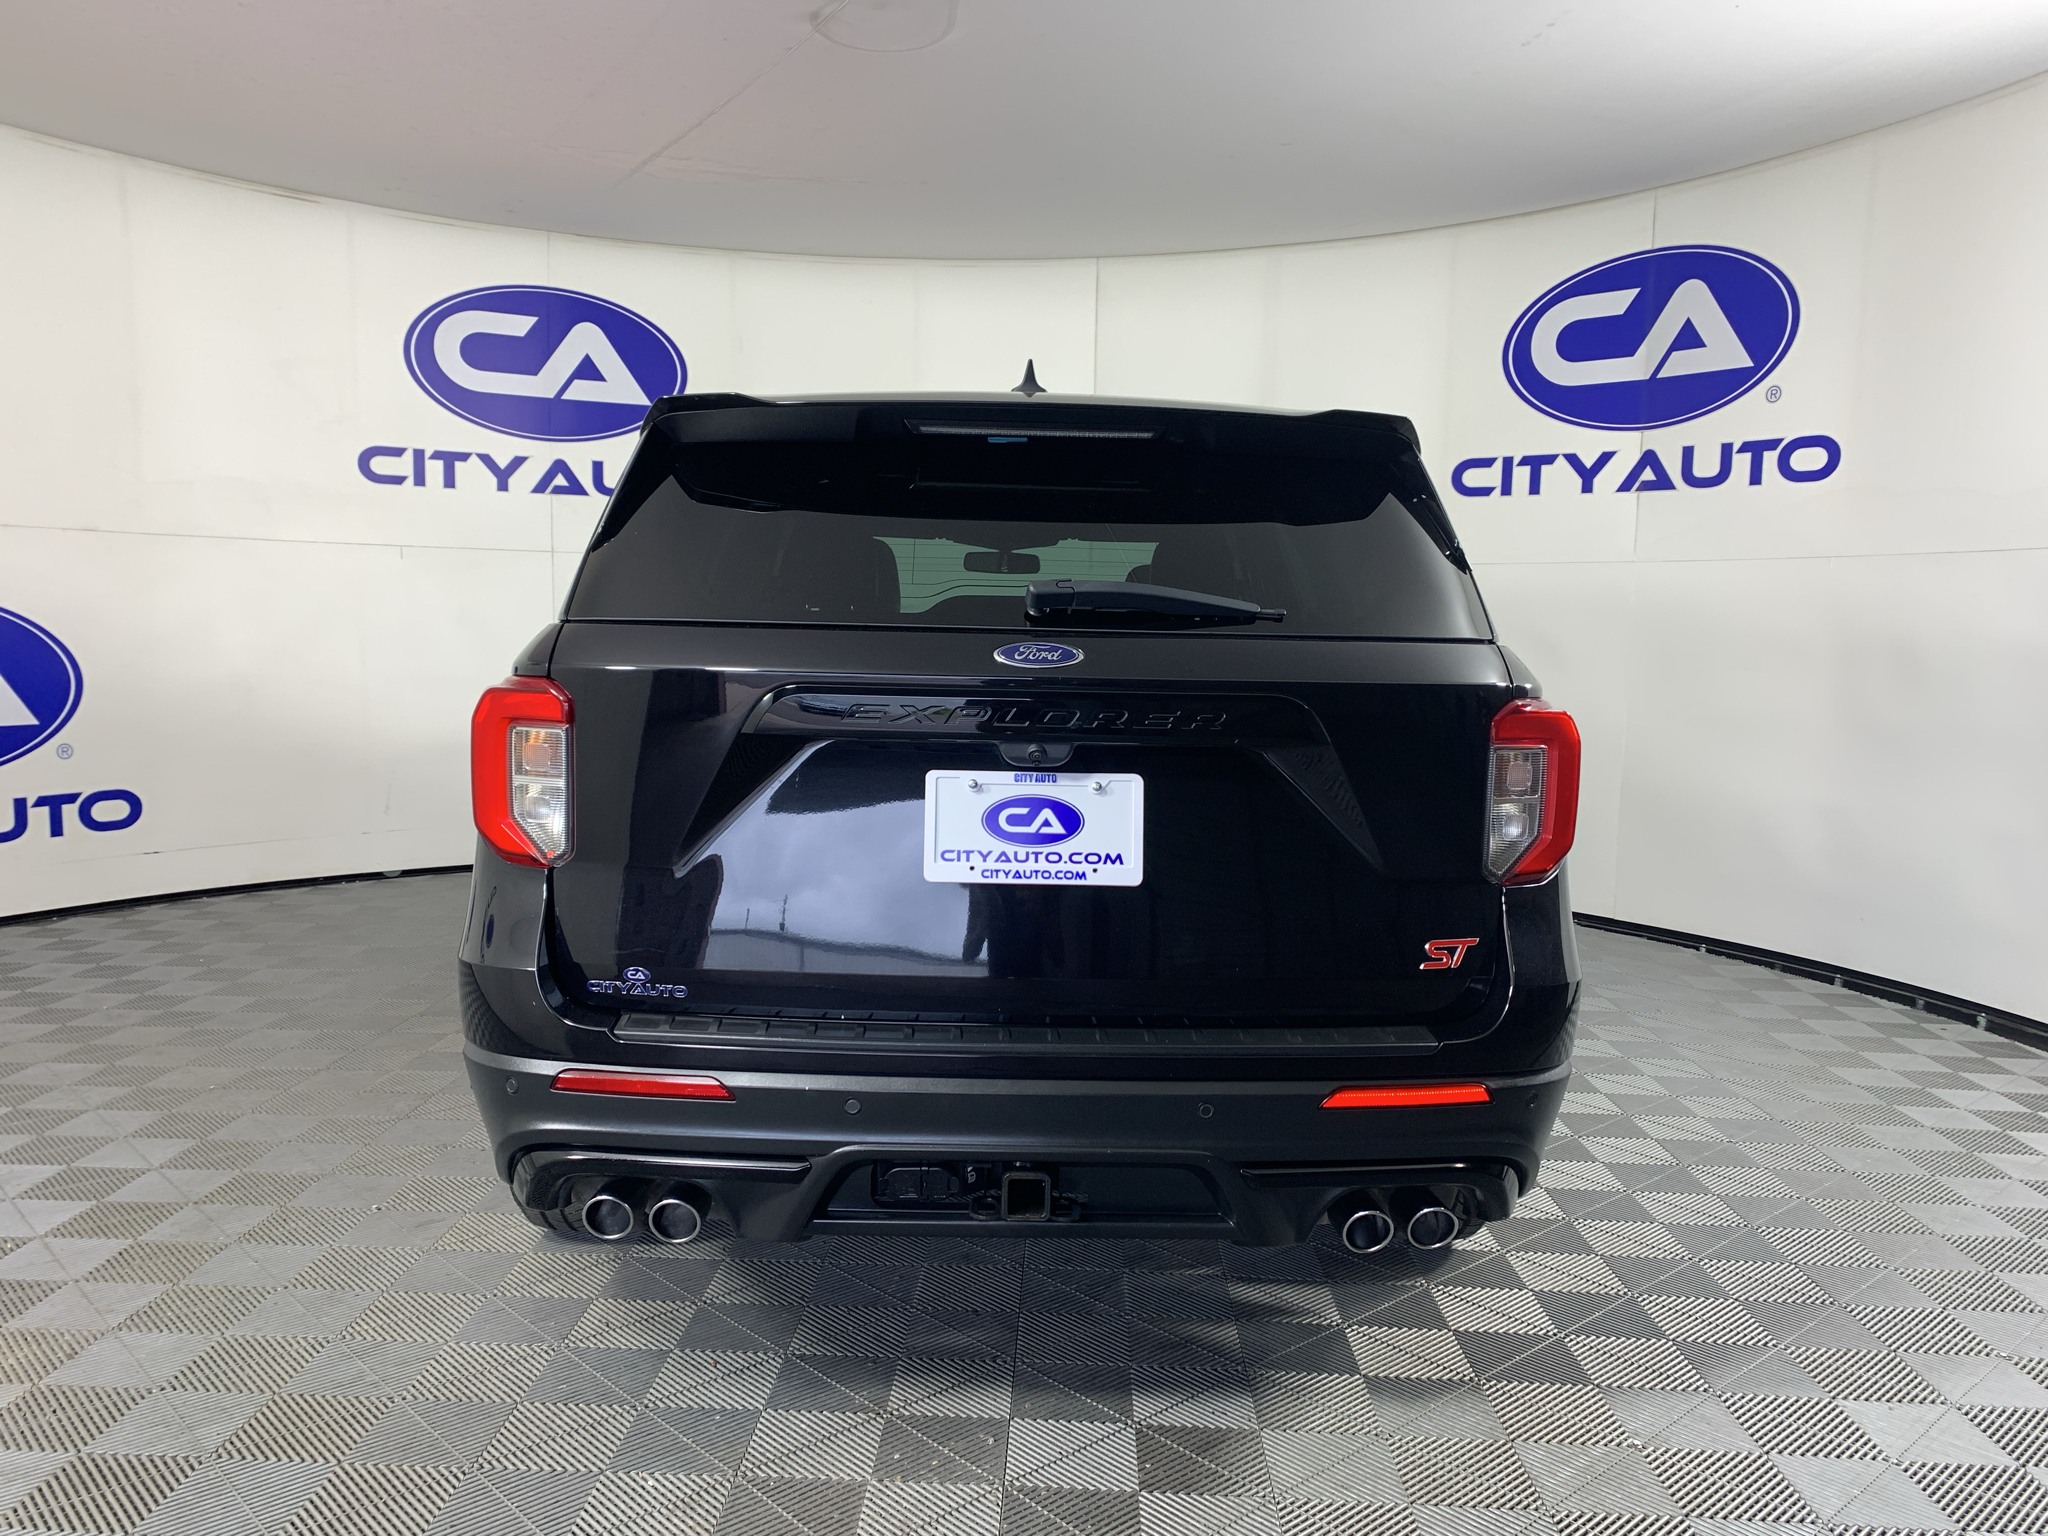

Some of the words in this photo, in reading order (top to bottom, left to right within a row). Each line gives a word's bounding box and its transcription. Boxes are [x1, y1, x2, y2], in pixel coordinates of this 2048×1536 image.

[1531, 278, 1754, 386] CA
[433, 310, 652, 406] CA
[1014, 644, 1062, 661] Ford
[841, 703, 1227, 730] EXPLORER
[0, 789, 142, 843] UTO
[998, 807, 1068, 834] CA
[940, 850, 1124, 866] CITYAUTO.COM
[981, 869, 1087, 881] CITYAUTO.COM
[1419, 937, 1480, 970] ST
[627, 970, 646, 980] CA
